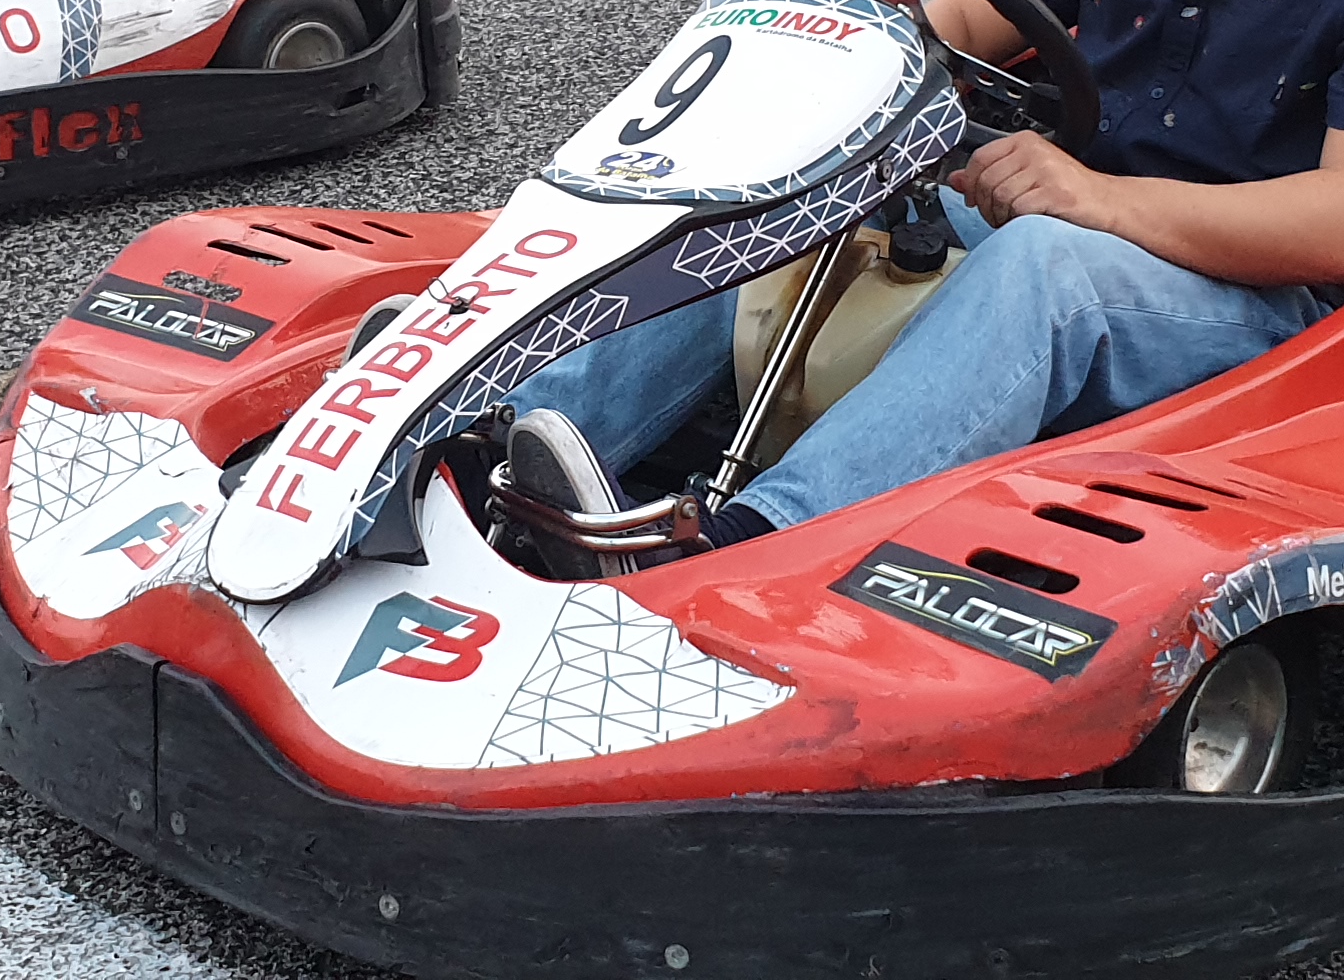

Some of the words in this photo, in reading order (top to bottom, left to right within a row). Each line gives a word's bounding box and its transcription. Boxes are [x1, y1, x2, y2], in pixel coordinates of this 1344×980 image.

[693, 7, 865, 41] EUROINDY
[618, 34, 732, 146] 9
[87, 290, 255, 351] PALOCAR
[256, 229, 578, 523] FERBERTO
[861, 562, 1093, 658] PALOCAR
